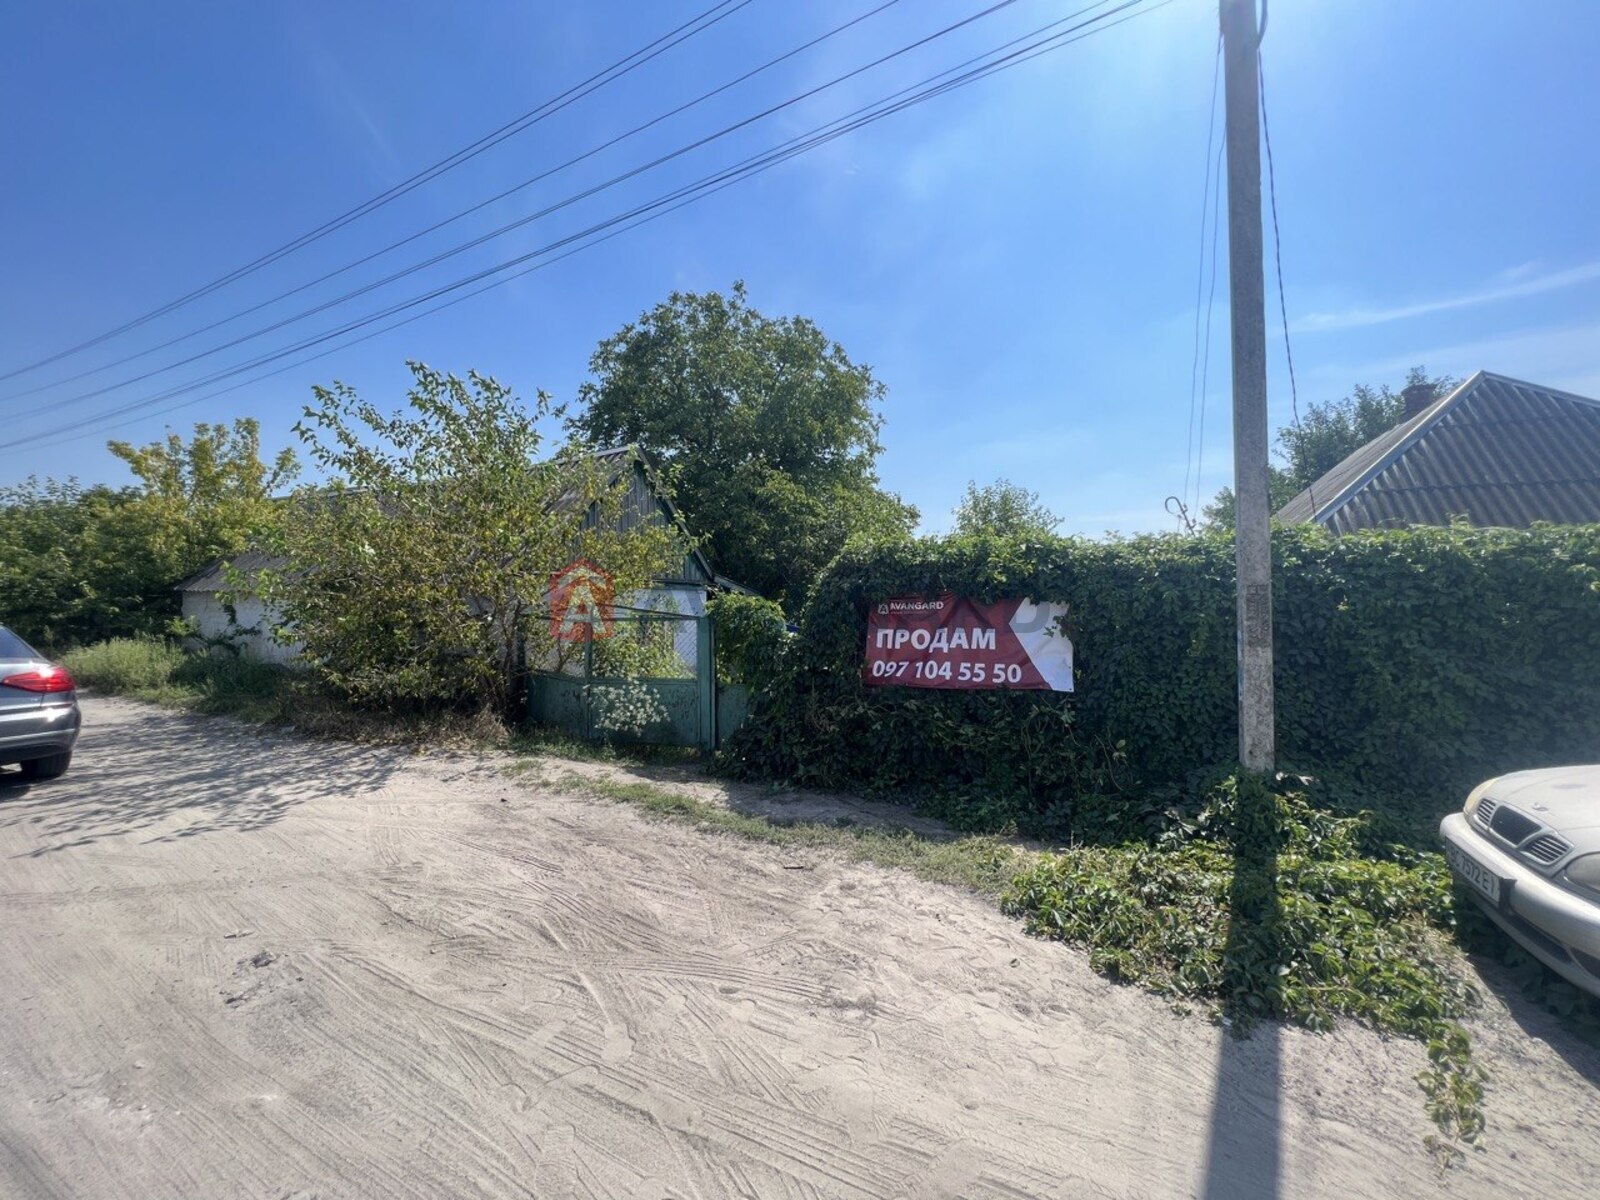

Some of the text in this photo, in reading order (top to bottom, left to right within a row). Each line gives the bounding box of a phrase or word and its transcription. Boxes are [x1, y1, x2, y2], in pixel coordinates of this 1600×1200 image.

[890, 601, 945, 610] AVANGARD
[876, 627, 996, 653] ПРОДАМ
[872, 660, 1022, 684] 097 104 55 50
